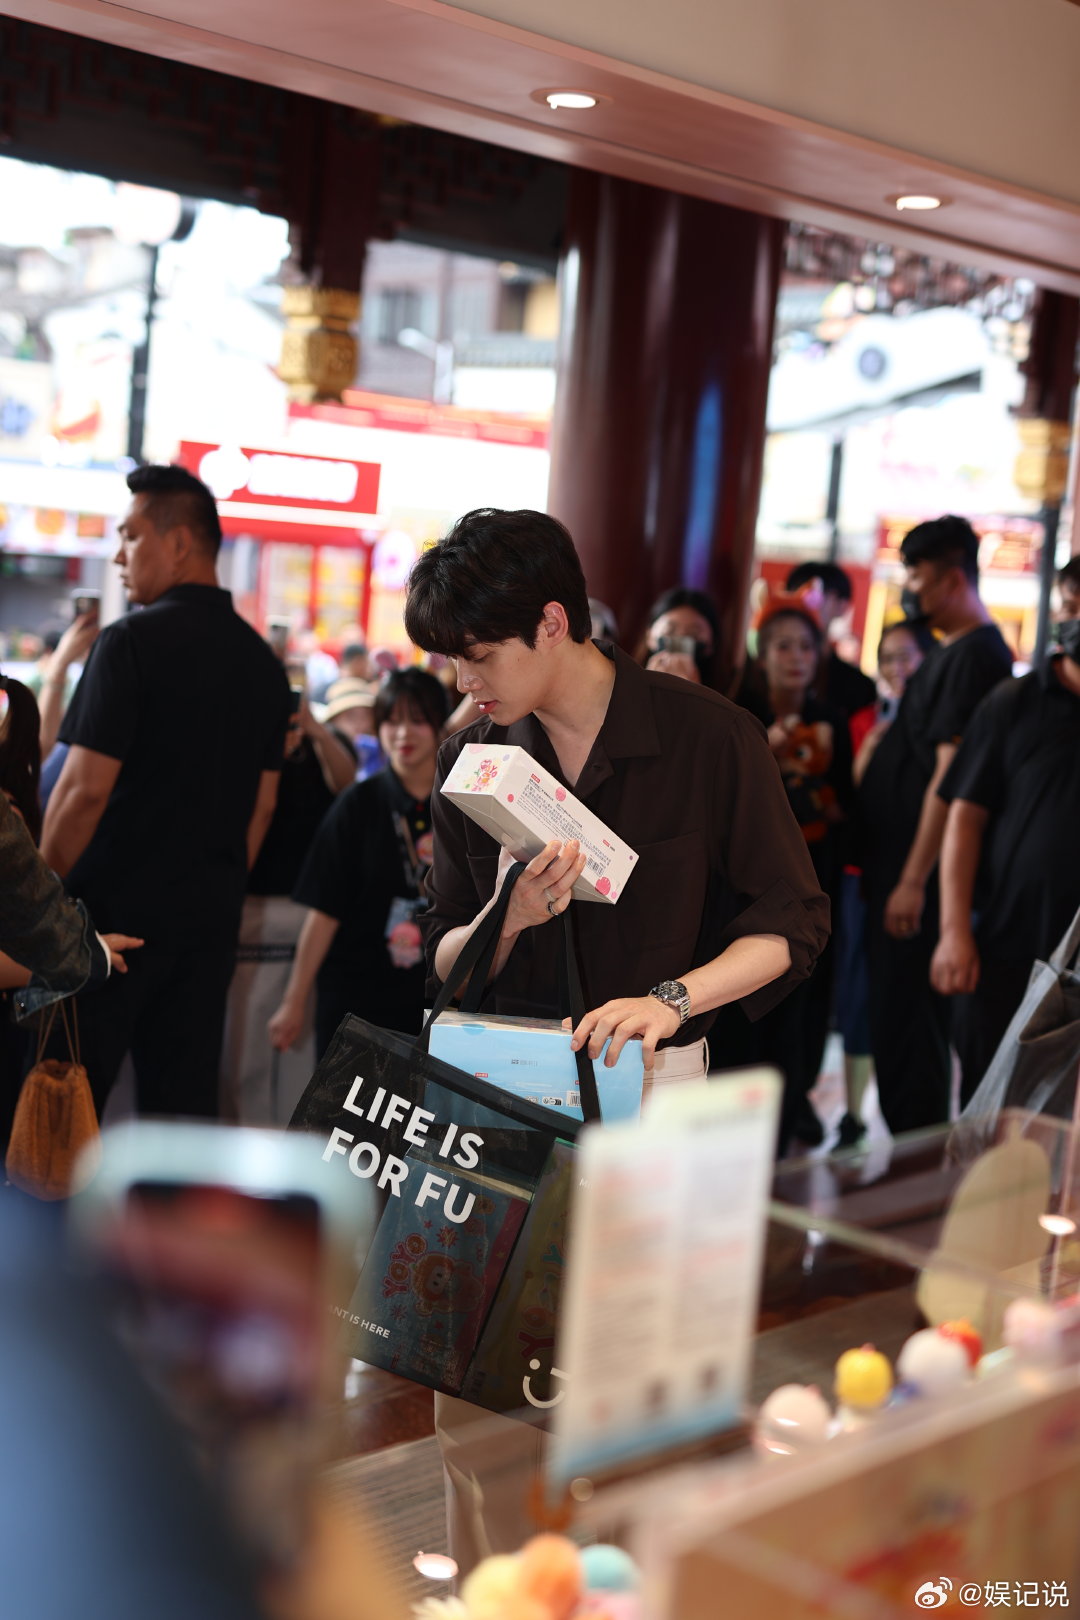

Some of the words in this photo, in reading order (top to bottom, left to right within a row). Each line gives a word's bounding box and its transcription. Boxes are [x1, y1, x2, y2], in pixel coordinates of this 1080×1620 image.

[342, 1075, 436, 1148] LIFE
[438, 1122, 485, 1169] IS
[321, 1126, 409, 1198] FOR
[414, 1171, 477, 1224] FU
[349, 1313, 360, 1325] IS
[360, 1319, 391, 1339] HERE
